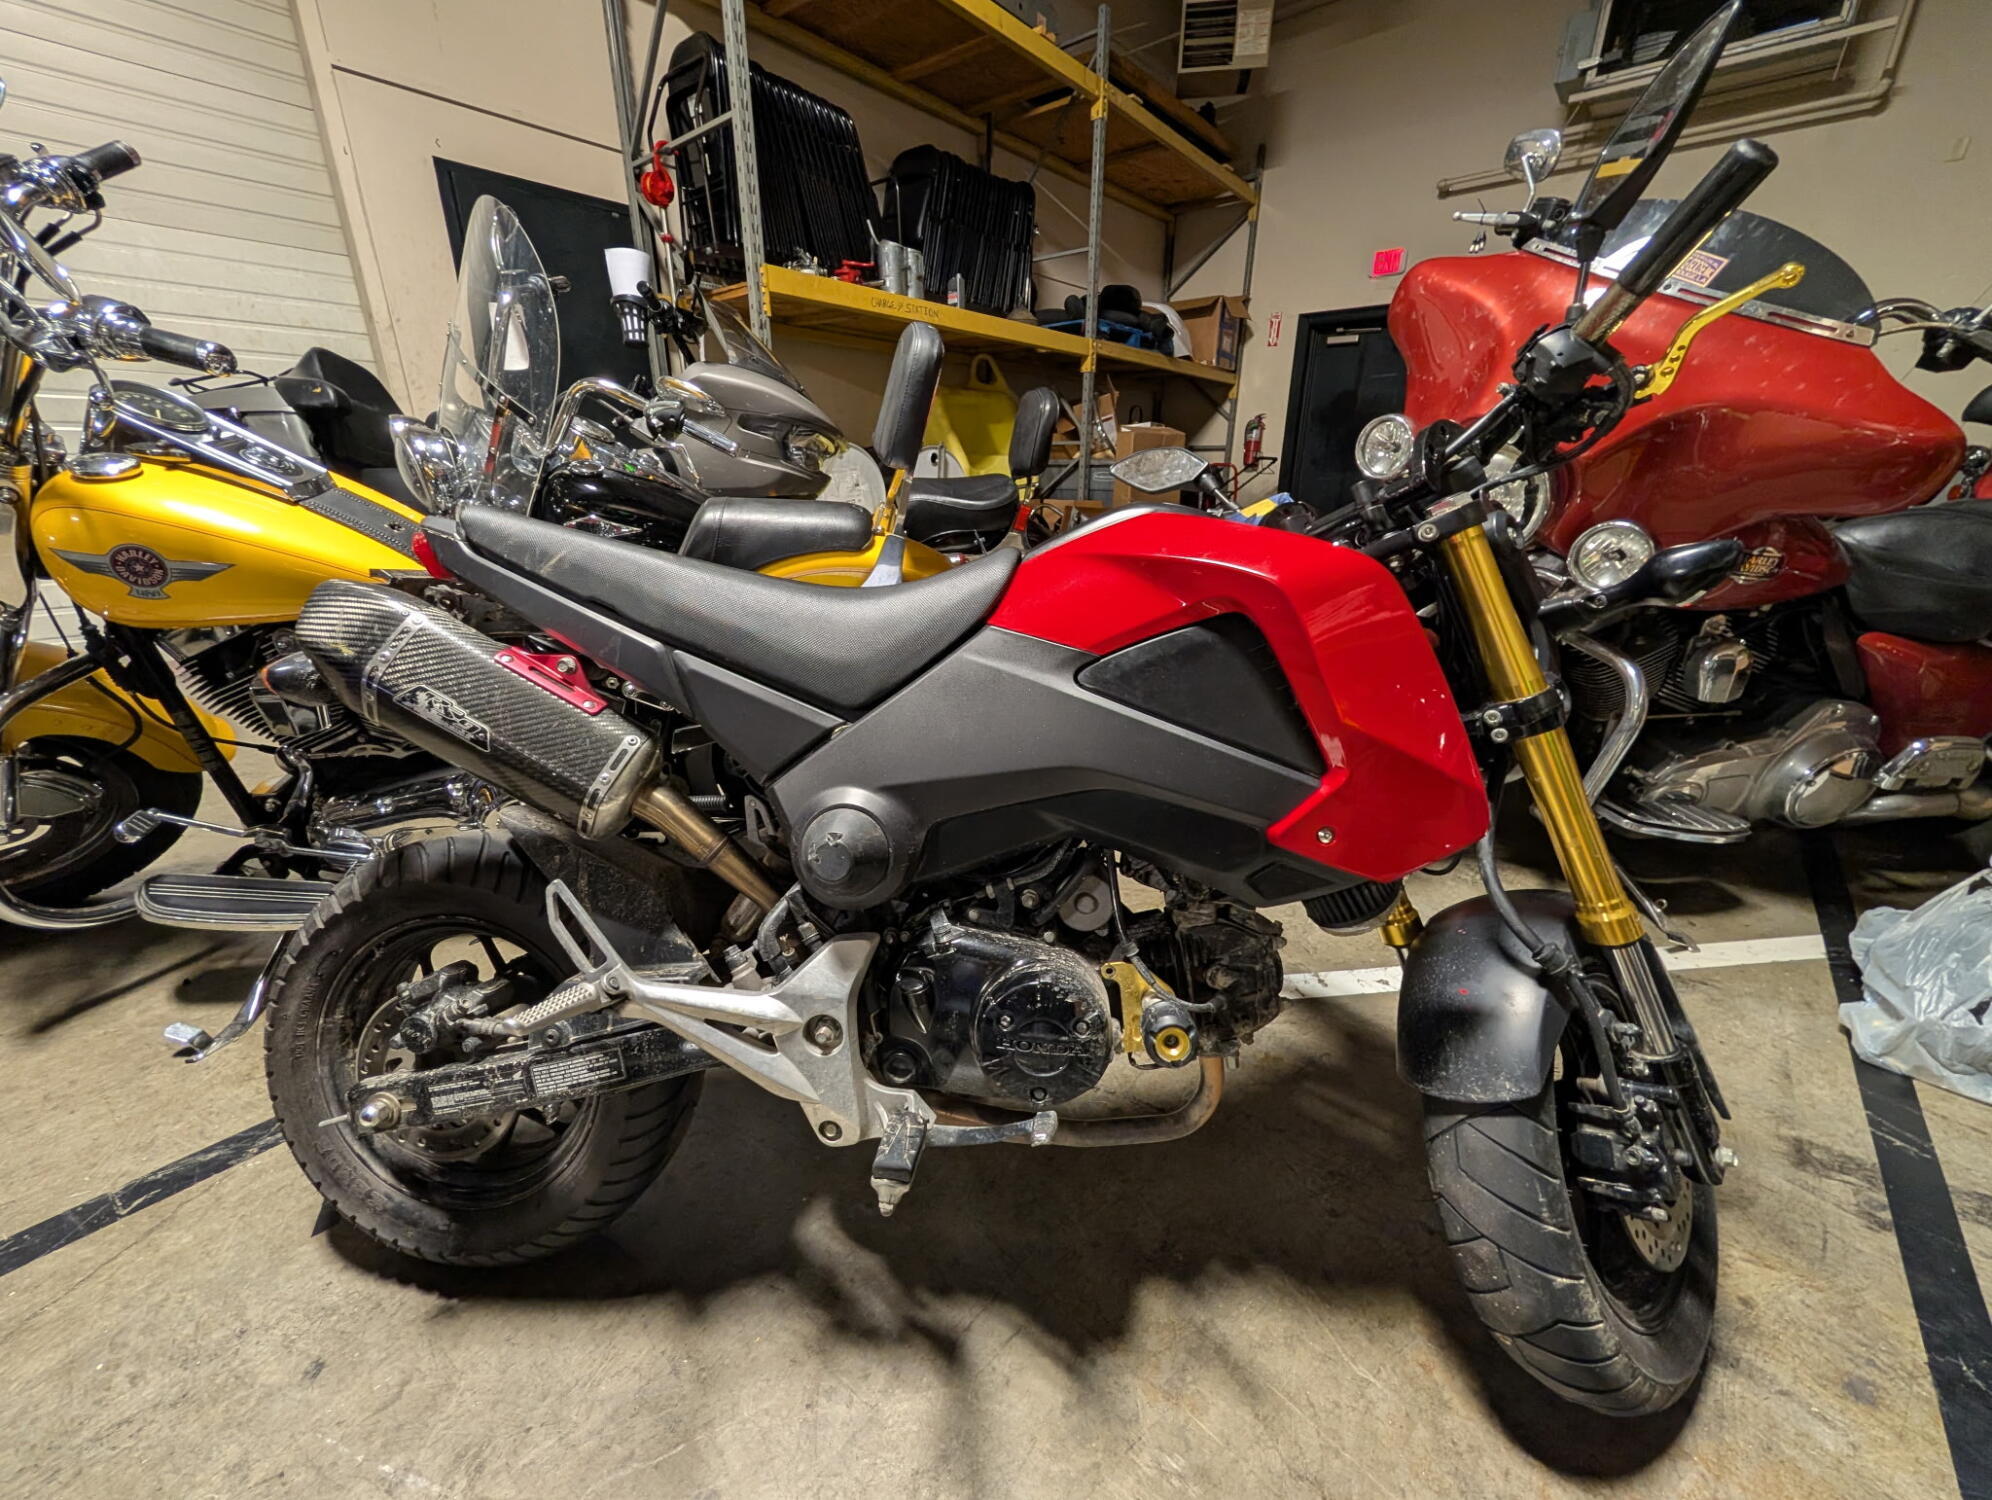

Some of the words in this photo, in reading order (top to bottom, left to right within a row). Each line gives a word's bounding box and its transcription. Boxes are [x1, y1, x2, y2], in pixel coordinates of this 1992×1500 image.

[115, 549, 159, 564] HARLEY
[115, 566, 164, 585] DAVIDSON
[996, 1038, 1090, 1057] HONDA
